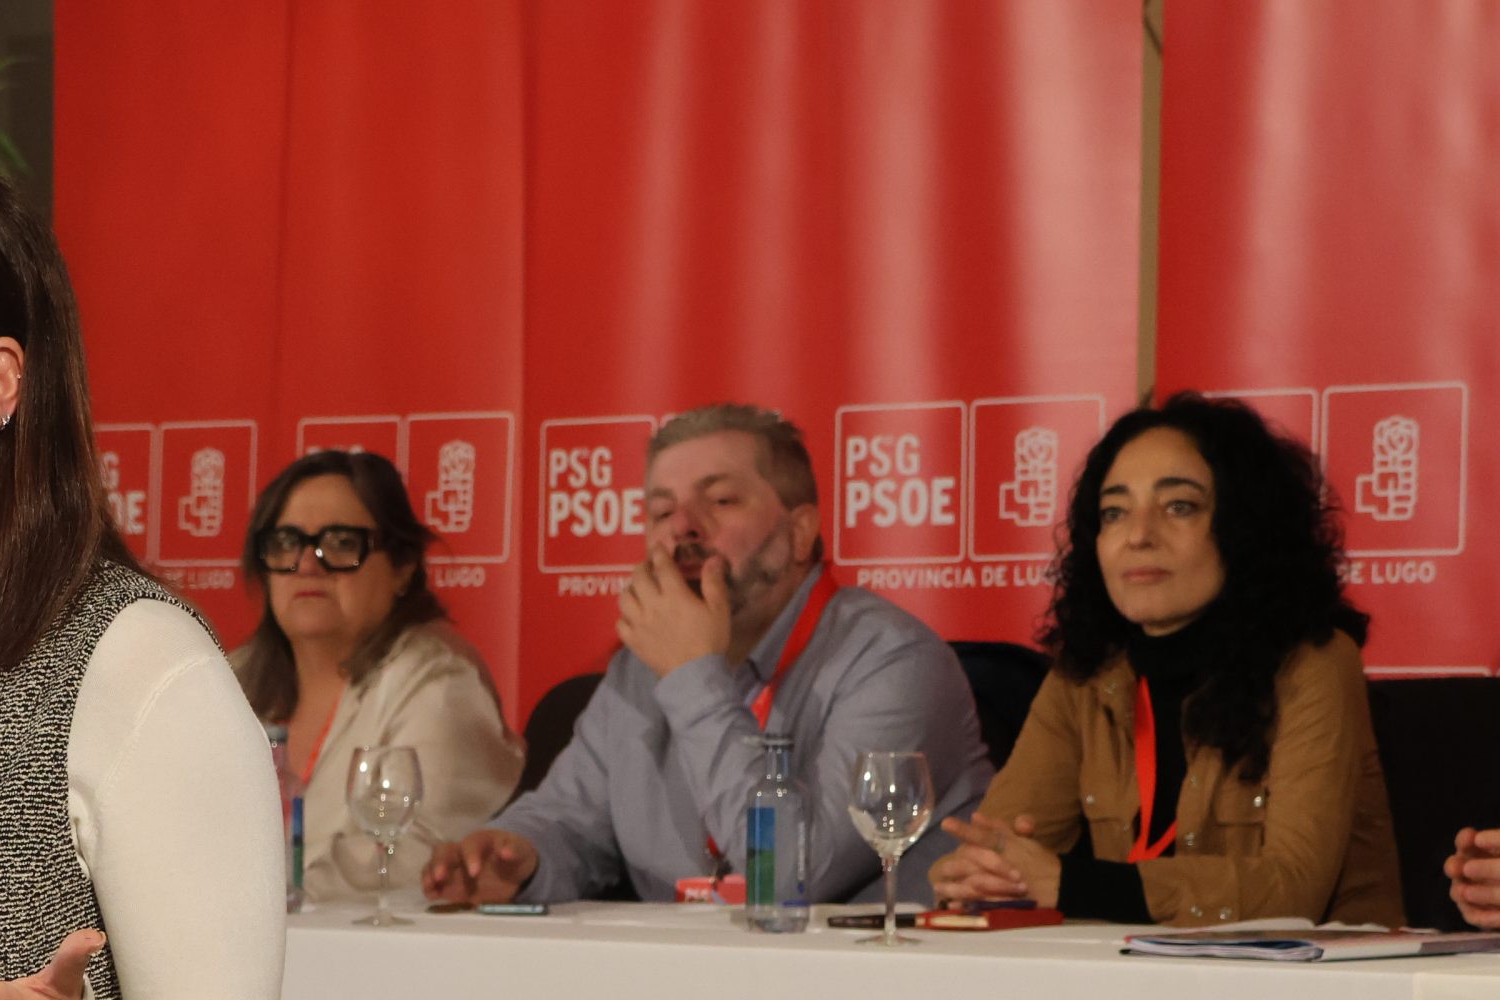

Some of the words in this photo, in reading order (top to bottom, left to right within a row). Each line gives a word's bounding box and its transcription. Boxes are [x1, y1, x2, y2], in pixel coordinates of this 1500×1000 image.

[549, 446, 613, 488] PSG
[846, 433, 920, 477] PSG
[549, 488, 645, 537] PSOE
[845, 476, 956, 528] PSOE
[434, 566, 486, 588] LUGO
[856, 565, 977, 590] PROVINCIA
[981, 564, 1008, 587] DE
[1370, 560, 1437, 584] LUGO
